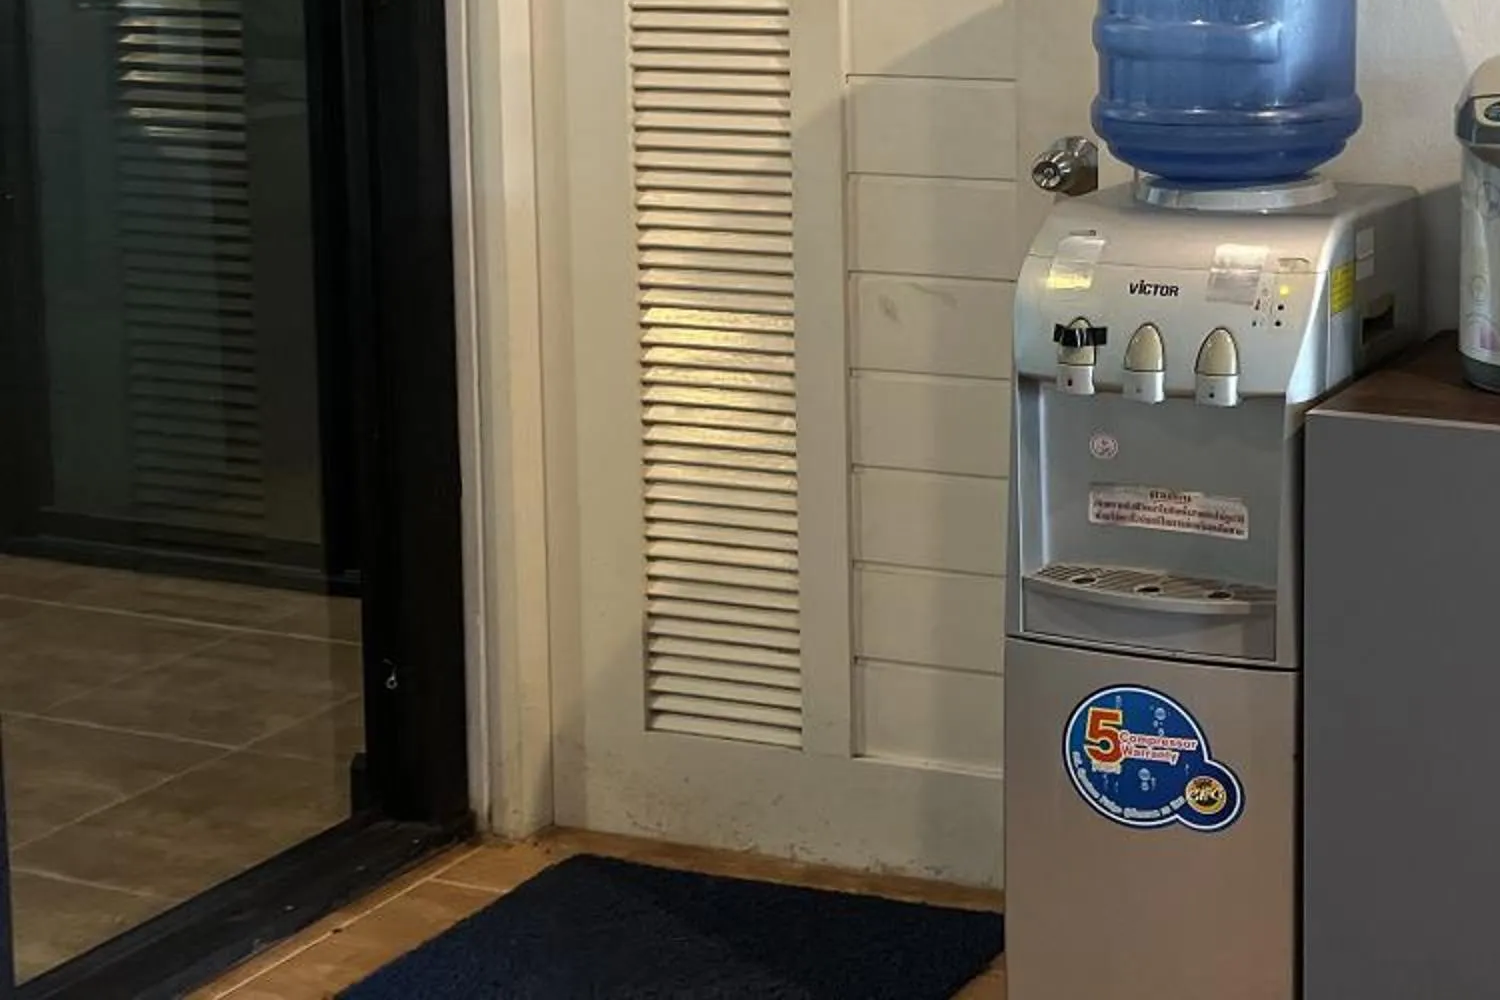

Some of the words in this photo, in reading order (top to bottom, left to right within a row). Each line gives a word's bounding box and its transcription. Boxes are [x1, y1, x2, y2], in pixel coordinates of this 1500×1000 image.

[1085, 707, 1123, 764] 5
[1119, 730, 1198, 751] Compressor
[1120, 743, 1180, 765] Warranty
